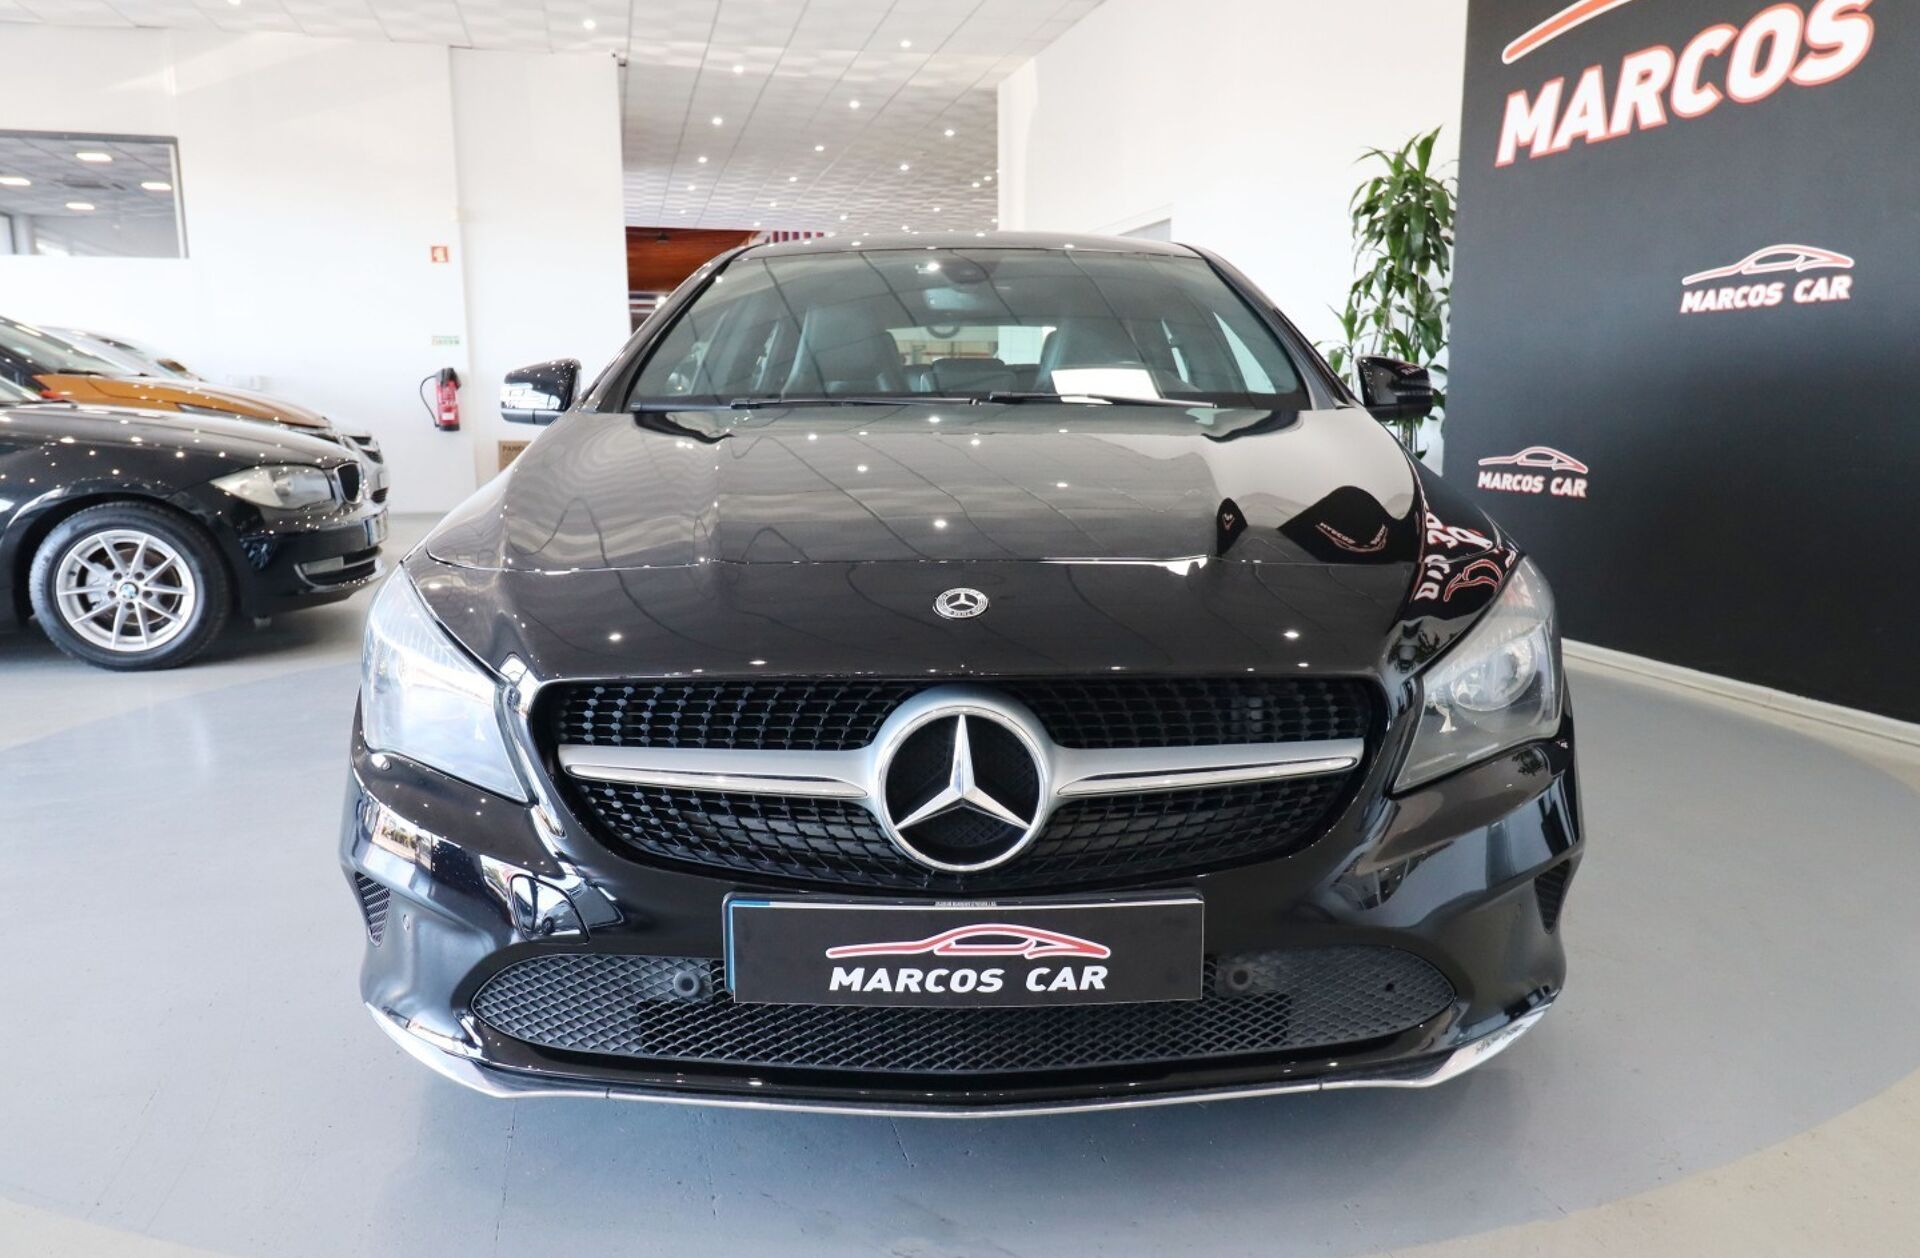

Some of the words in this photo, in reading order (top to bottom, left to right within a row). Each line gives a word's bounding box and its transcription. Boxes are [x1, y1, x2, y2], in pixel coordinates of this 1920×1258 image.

[1495, 0, 1874, 167] MARCOS
[1680, 282, 1785, 314] MARCOS
[1793, 274, 1853, 304] CAR
[1477, 471, 1545, 494] MARCOS
[1550, 477, 1588, 498] CAR
[829, 967, 1005, 992] MARCOS
[1025, 966, 1108, 992] CAR
